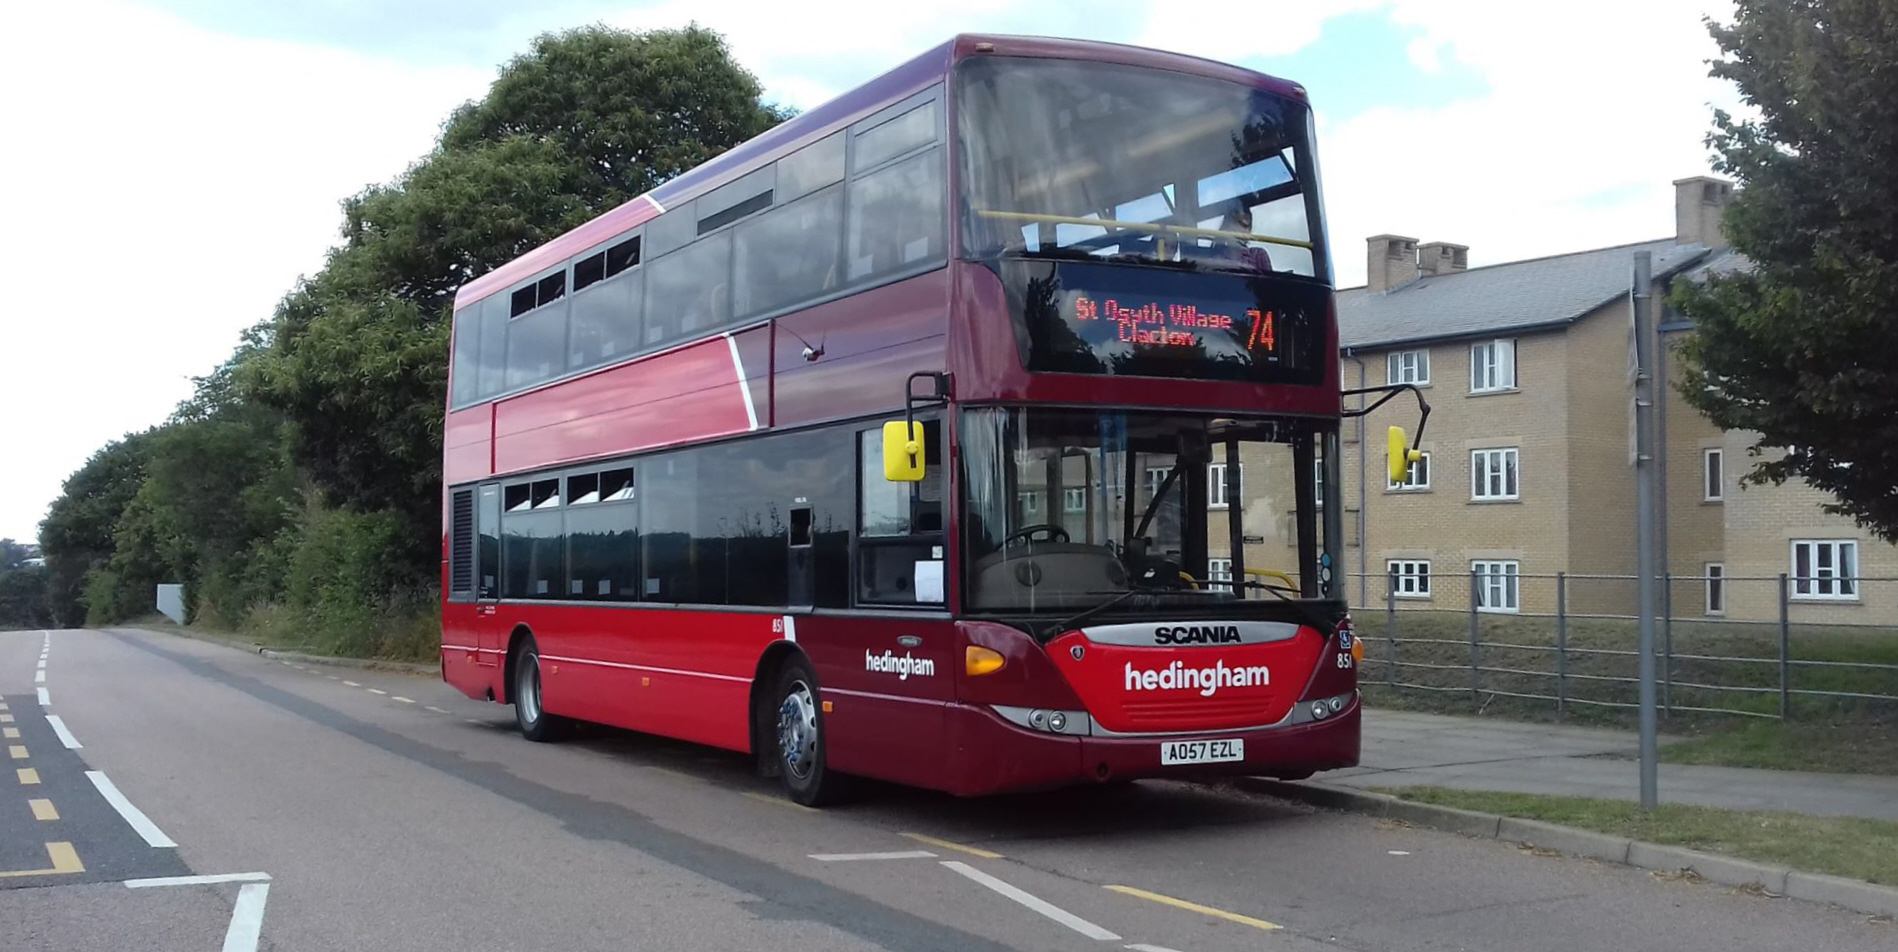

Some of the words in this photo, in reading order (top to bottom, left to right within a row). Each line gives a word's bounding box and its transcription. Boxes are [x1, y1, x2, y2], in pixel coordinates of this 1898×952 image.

[1075, 297, 1098, 320] St
[1105, 299, 1164, 325] Osyth
[1169, 304, 1233, 329] Village
[1118, 321, 1196, 347] Clacton
[1247, 309, 1274, 350] 74
[1154, 626, 1242, 645] SCANIA
[865, 648, 935, 680] hedingham
[1125, 659, 1270, 696] hedingham
[1169, 742, 1207, 761] AO57
[1210, 741, 1237, 759] EZL
